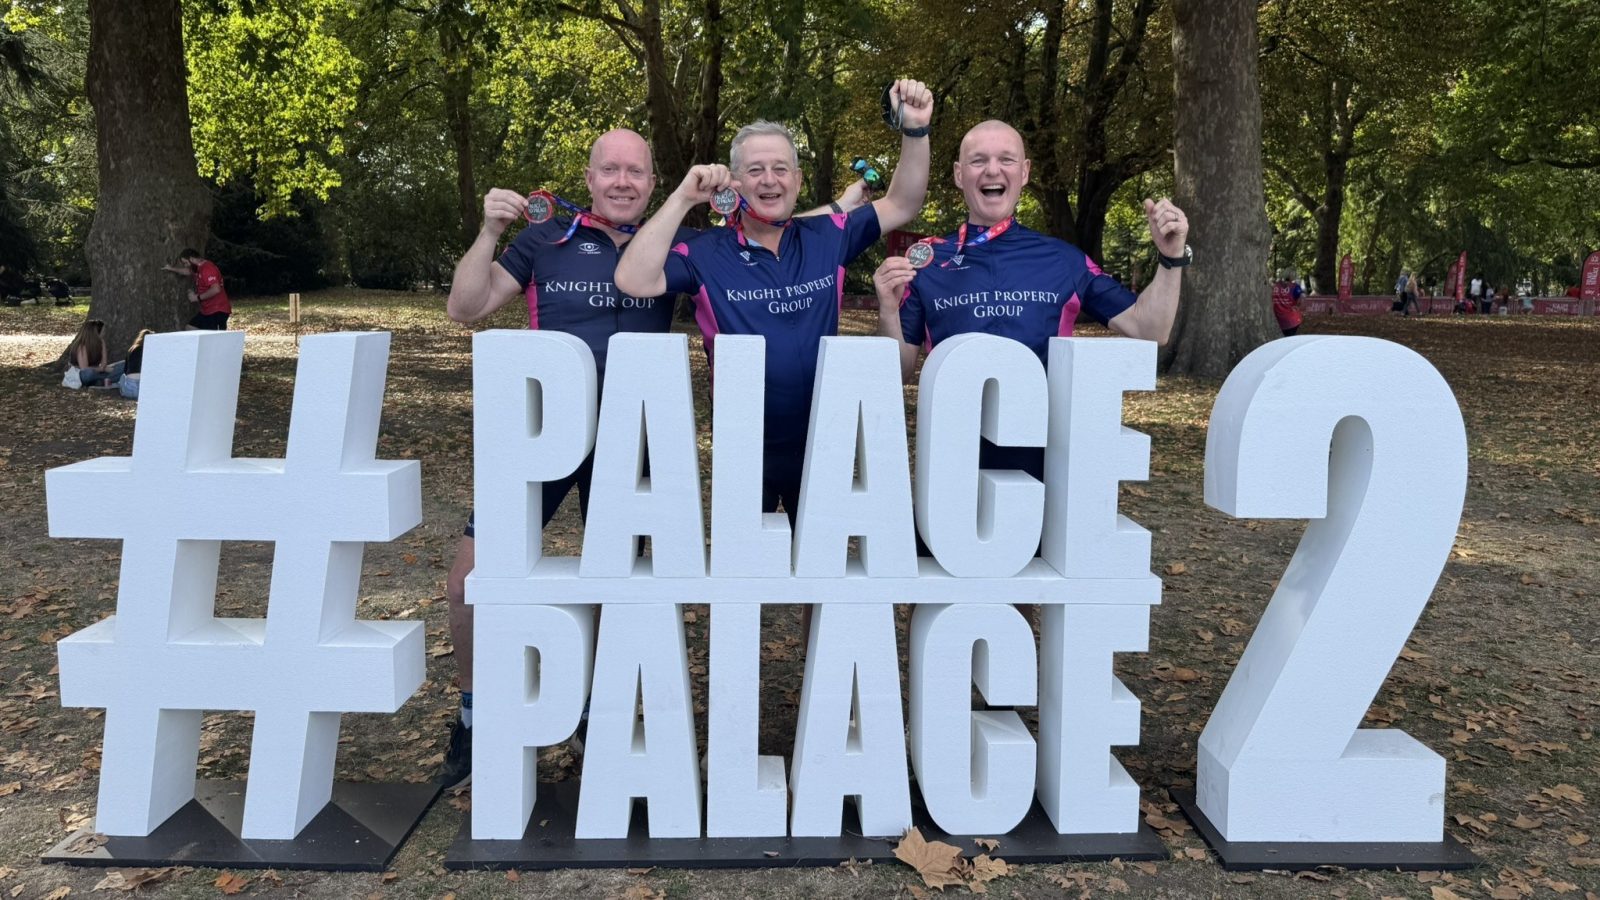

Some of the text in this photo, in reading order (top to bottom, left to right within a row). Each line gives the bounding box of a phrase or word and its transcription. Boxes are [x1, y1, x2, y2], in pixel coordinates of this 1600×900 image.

[545, 280, 613, 292] KNIGHT
[726, 274, 834, 301] KNIGHT PROPERTY
[589, 294, 655, 309] GROUP
[768, 297, 813, 314] GROUP
[934, 290, 1060, 311] KNIGHT PROPERTY
[974, 305, 1023, 318] GROUP
[471, 329, 1158, 579] PALACE
[1196, 335, 1469, 843] 2
[470, 602, 1151, 840] PALACE
